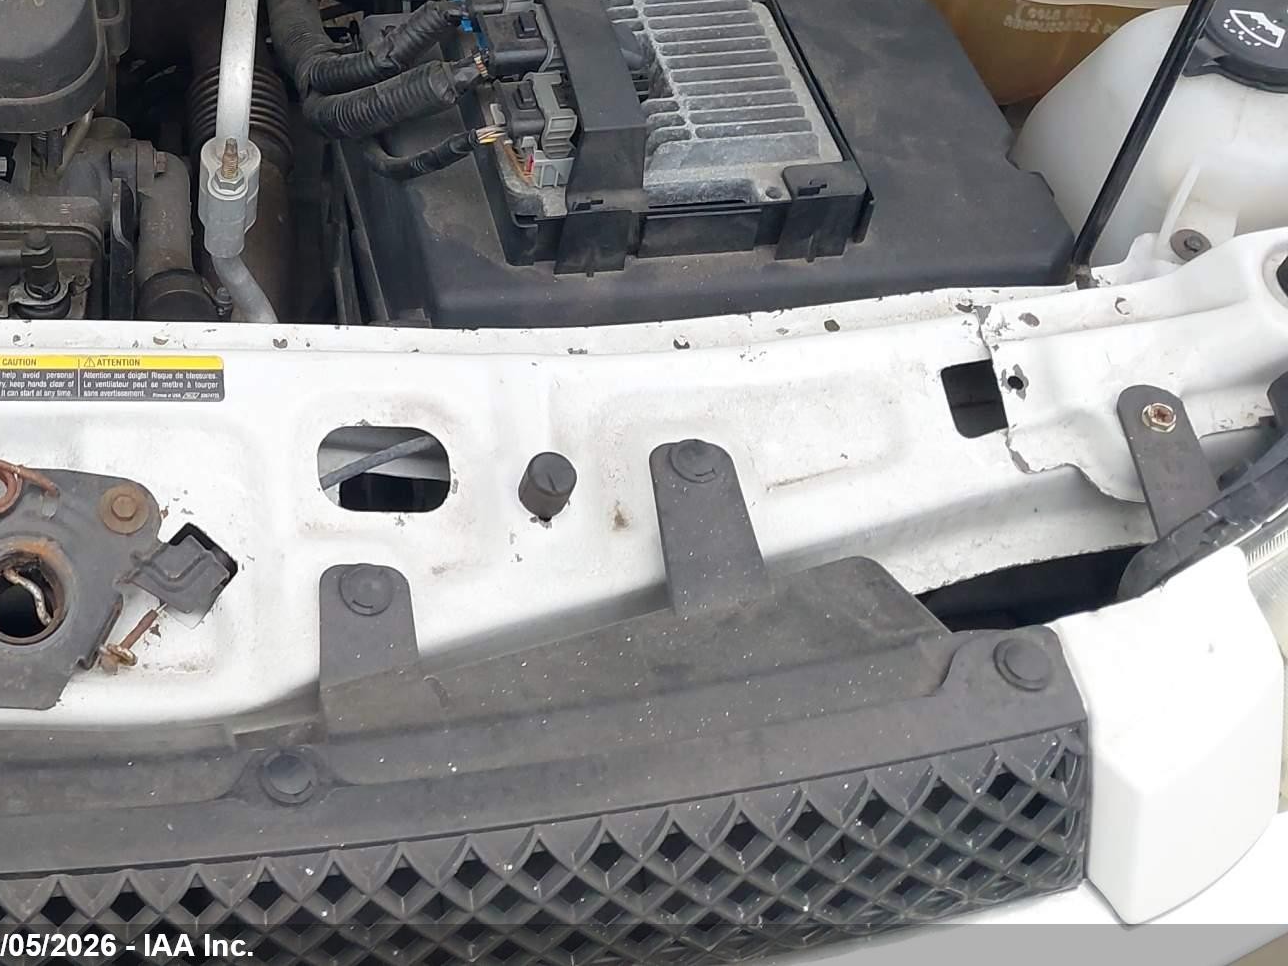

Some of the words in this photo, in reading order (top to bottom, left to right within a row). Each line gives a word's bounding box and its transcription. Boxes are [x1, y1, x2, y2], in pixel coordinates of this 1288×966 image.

[2, 358, 37, 367] CAUTION
[97, 358, 140, 367] ATTENTION
[2, 371, 16, 380] help
[23, 371, 41, 379] avoid
[46, 371, 75, 380] personal
[83, 371, 112, 379] Attention
[151, 372, 173, 380] Risque
[175, 372, 184, 380] de
[9, 380, 26, 389] keep
[27, 380, 46, 388] hands
[49, 380, 66, 388] clear
[67, 380, 75, 388] of
[95, 380, 128, 388] ventilateur
[132, 381, 147, 390] peut
[20, 389, 34, 397] start
[35, 389, 42, 397] at
[43, 390, 56, 398] any
[56, 389, 73, 397] time.
